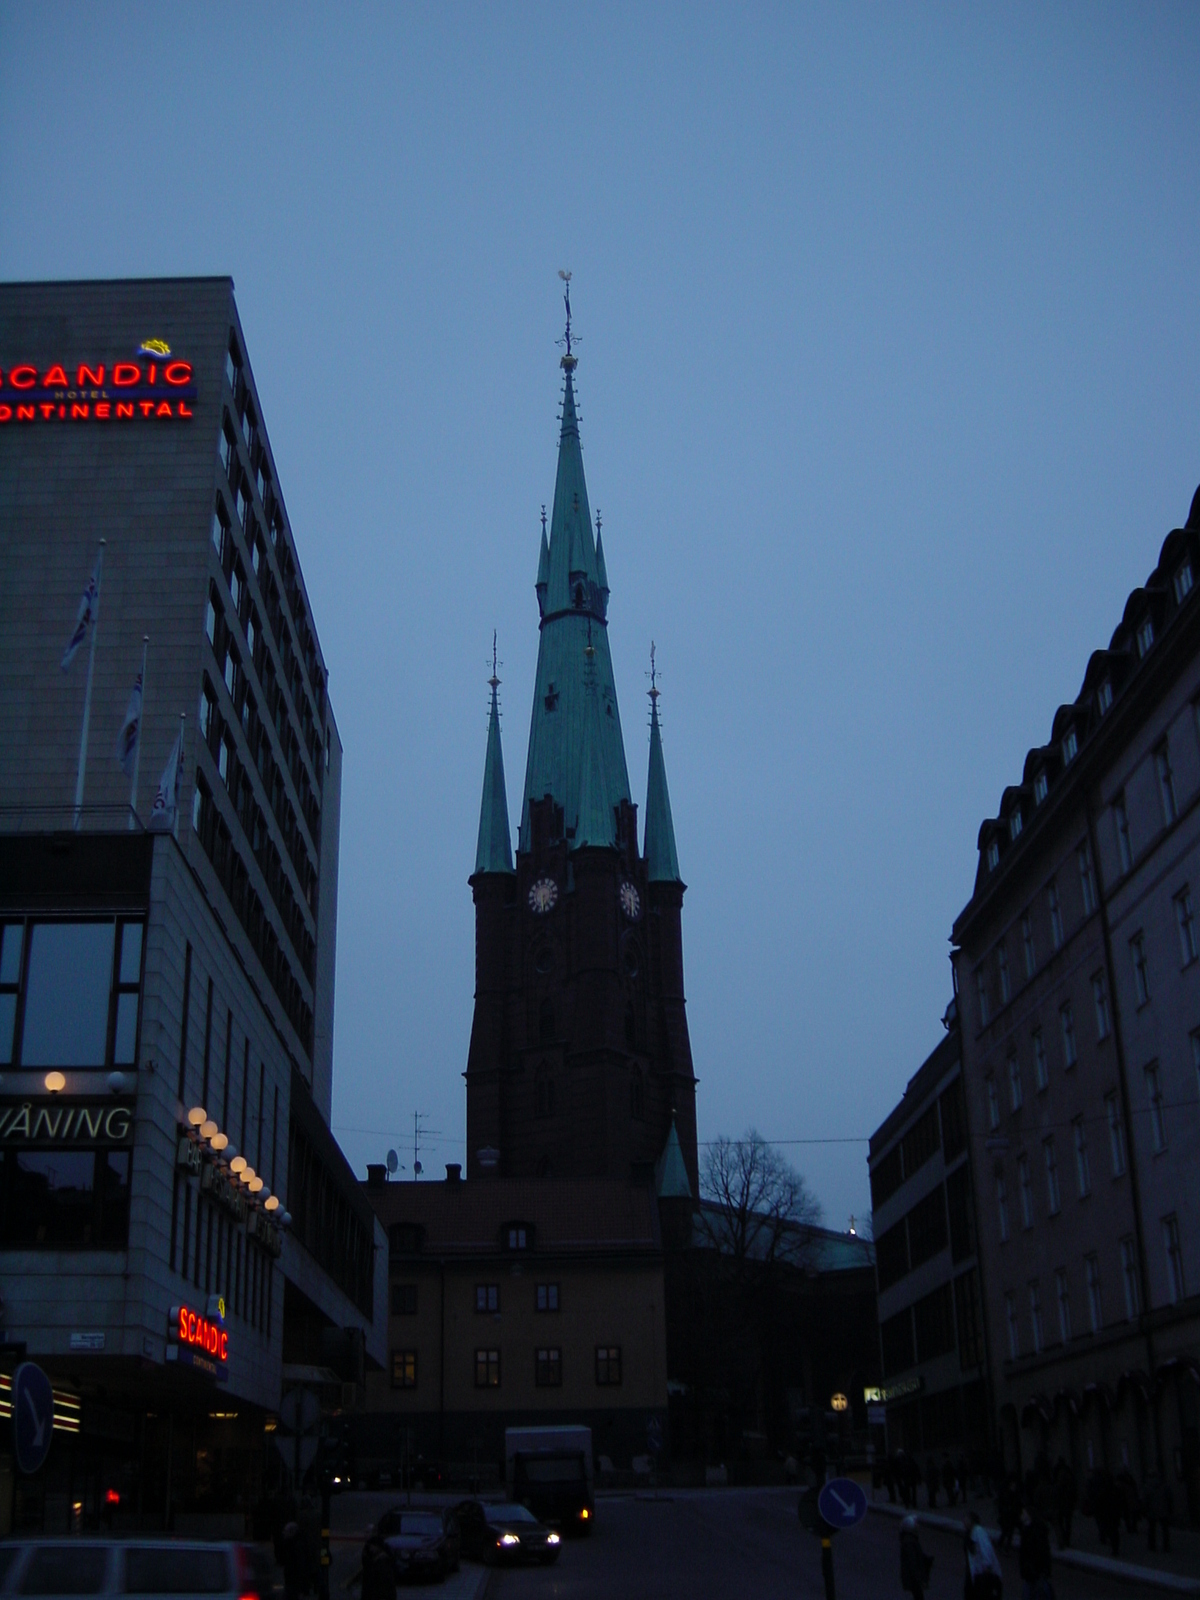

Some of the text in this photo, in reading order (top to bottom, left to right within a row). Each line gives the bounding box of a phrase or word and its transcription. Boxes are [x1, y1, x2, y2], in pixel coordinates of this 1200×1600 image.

[0, 361, 193, 389] CANDIC
[54, 390, 110, 400] HOTEL
[180, 1307, 229, 1361] SCANDIC
